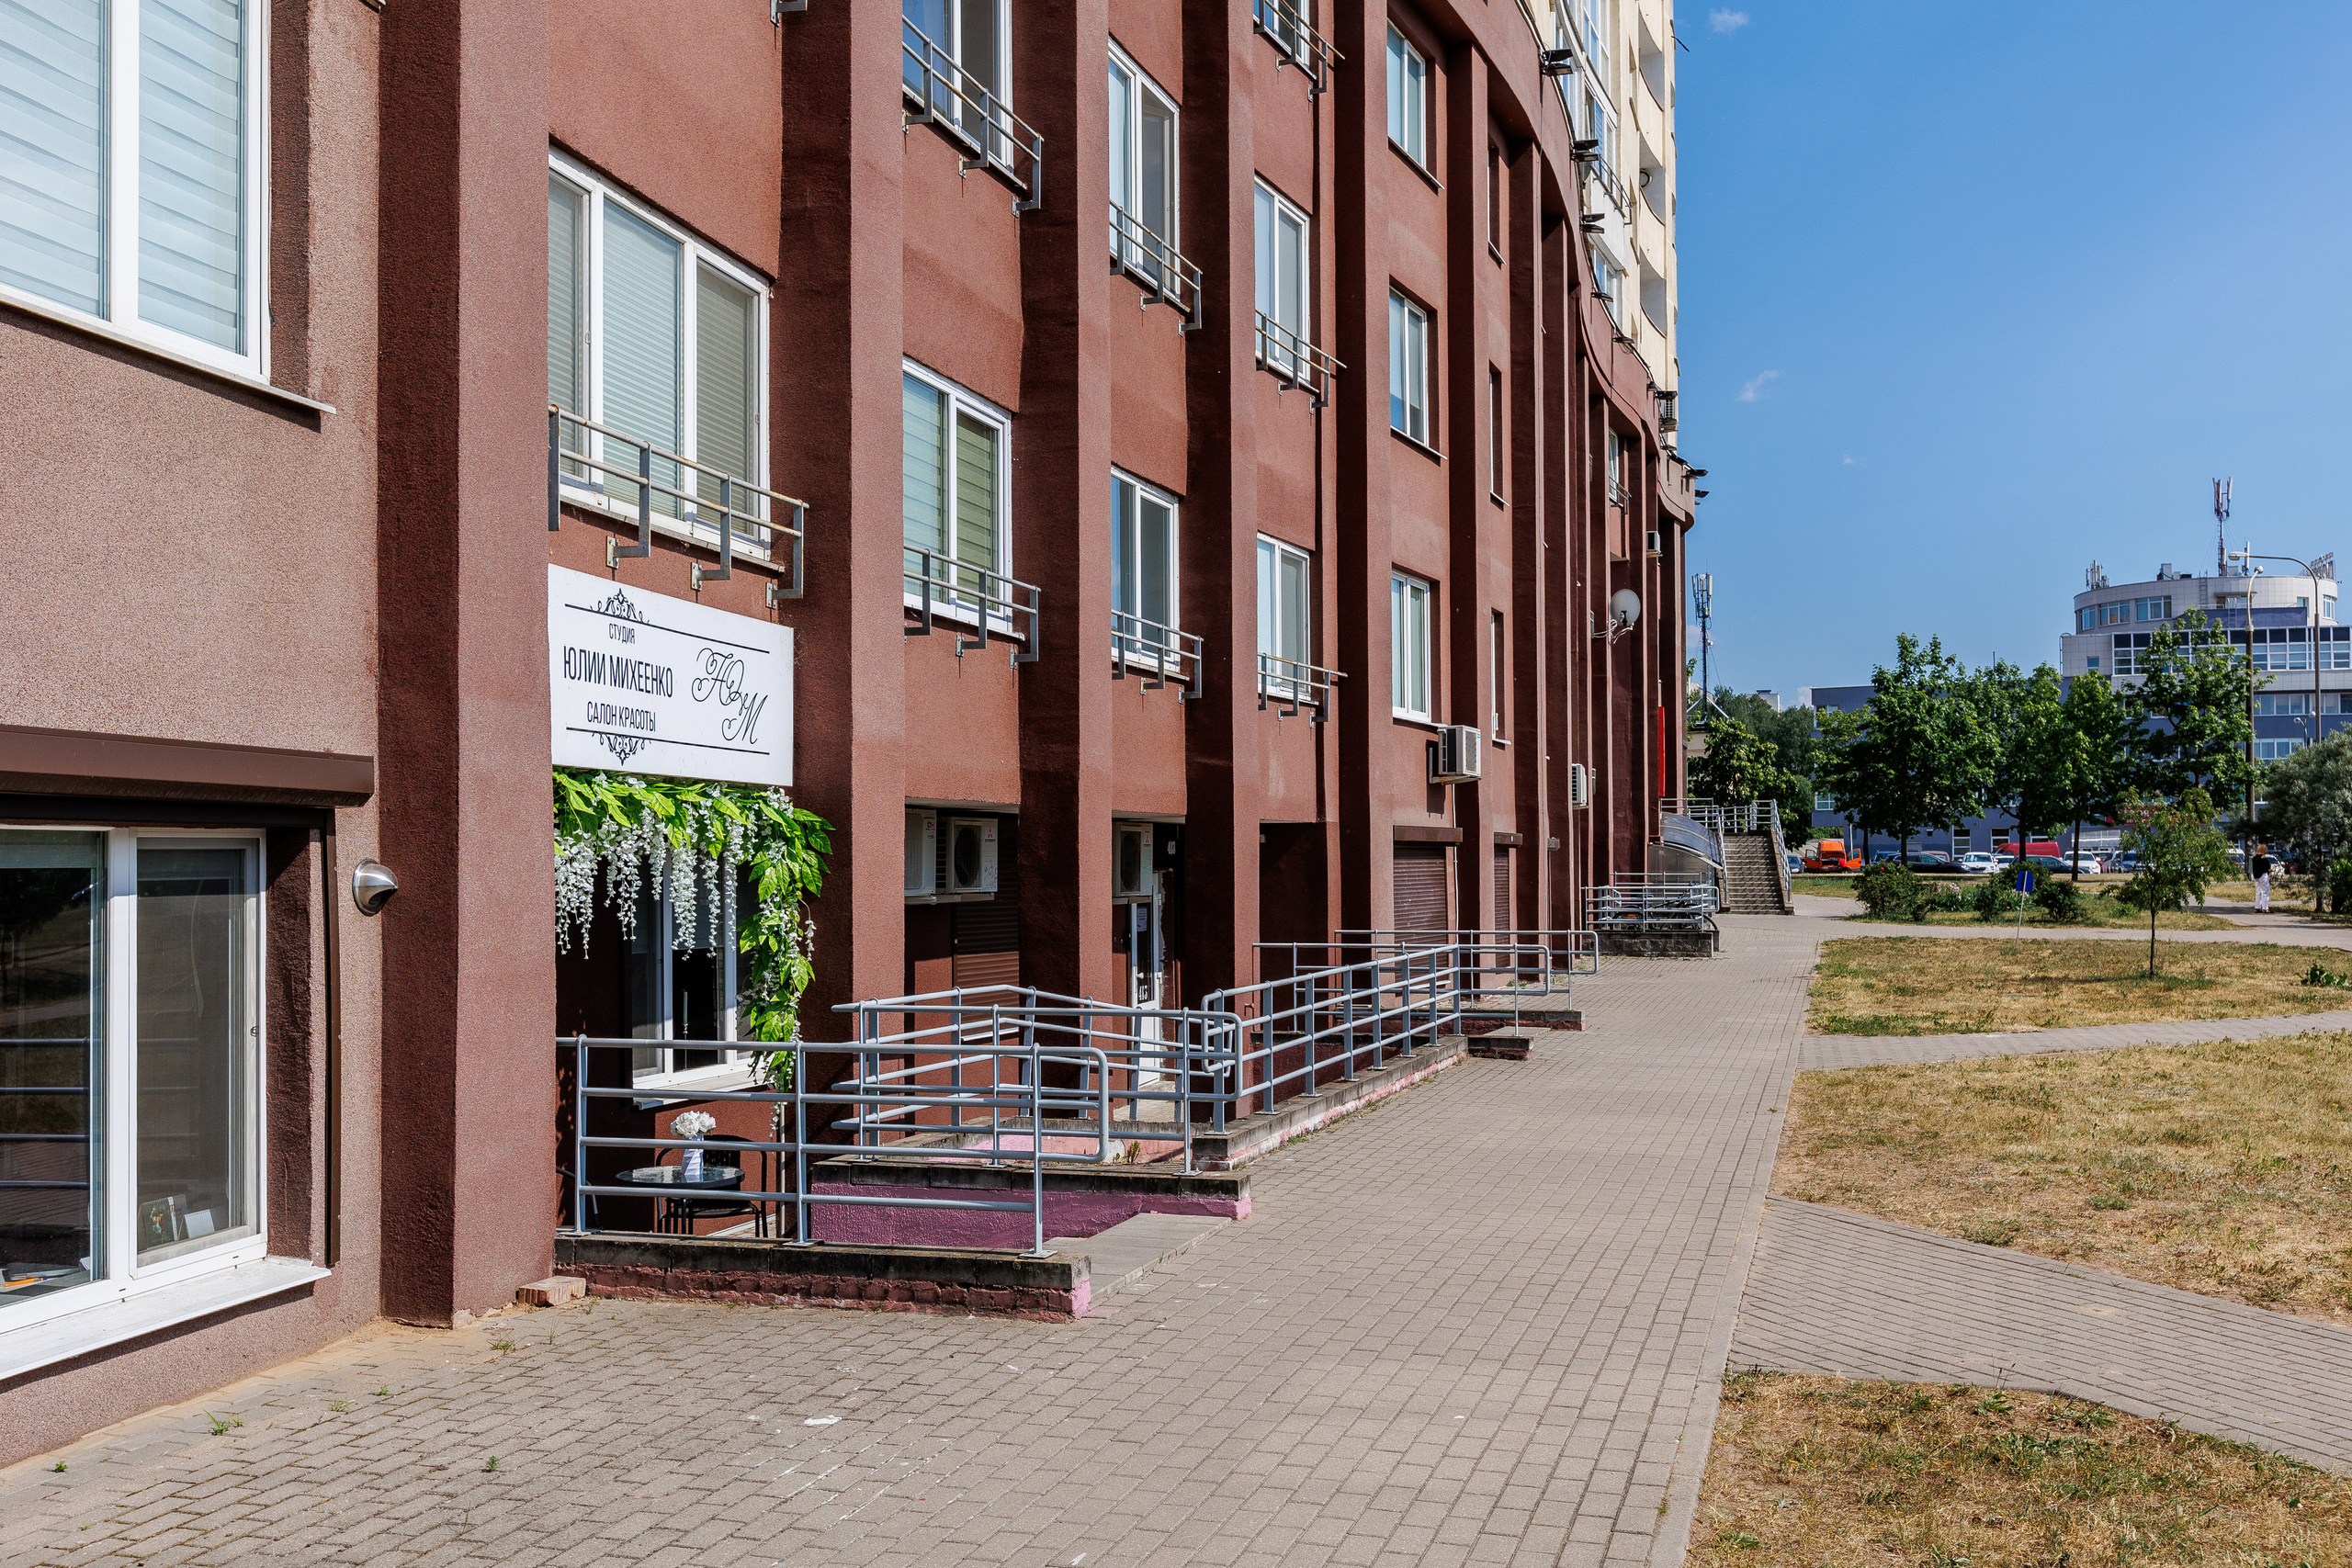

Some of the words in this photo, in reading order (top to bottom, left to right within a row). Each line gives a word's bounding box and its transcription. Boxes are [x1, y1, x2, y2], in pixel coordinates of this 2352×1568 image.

[608, 623, 636, 645] СТУДИЯ
[563, 645, 605, 686] ЮЛИИ
[609, 655, 673, 698] МИХЕЕНКО
[586, 701, 617, 725] САЛОН
[618, 705, 656, 732] КРАСОТЫ
